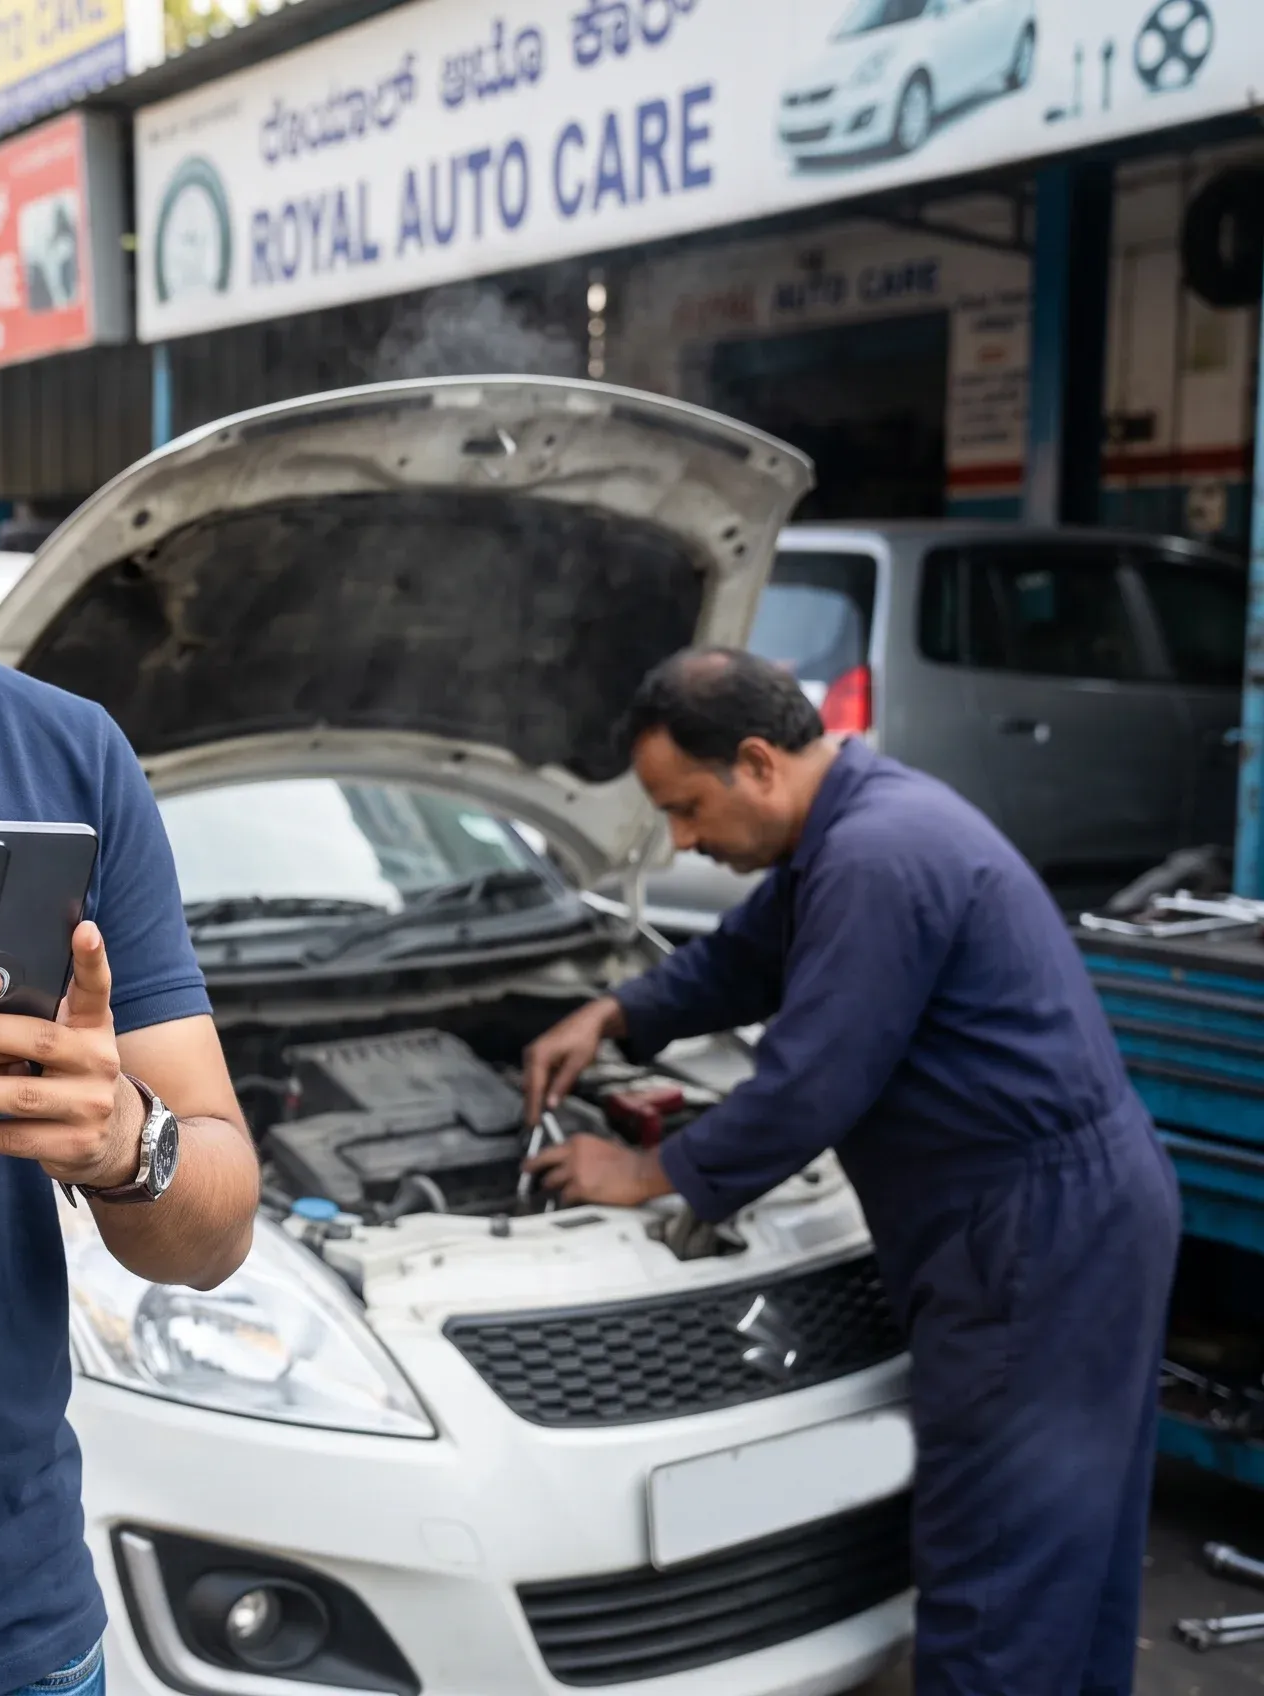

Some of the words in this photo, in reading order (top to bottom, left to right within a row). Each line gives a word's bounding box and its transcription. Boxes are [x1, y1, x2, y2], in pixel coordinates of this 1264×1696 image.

[250, 180, 379, 286] ROYAL
[394, 138, 530, 256] AUTO
[552, 82, 714, 218] CARE
